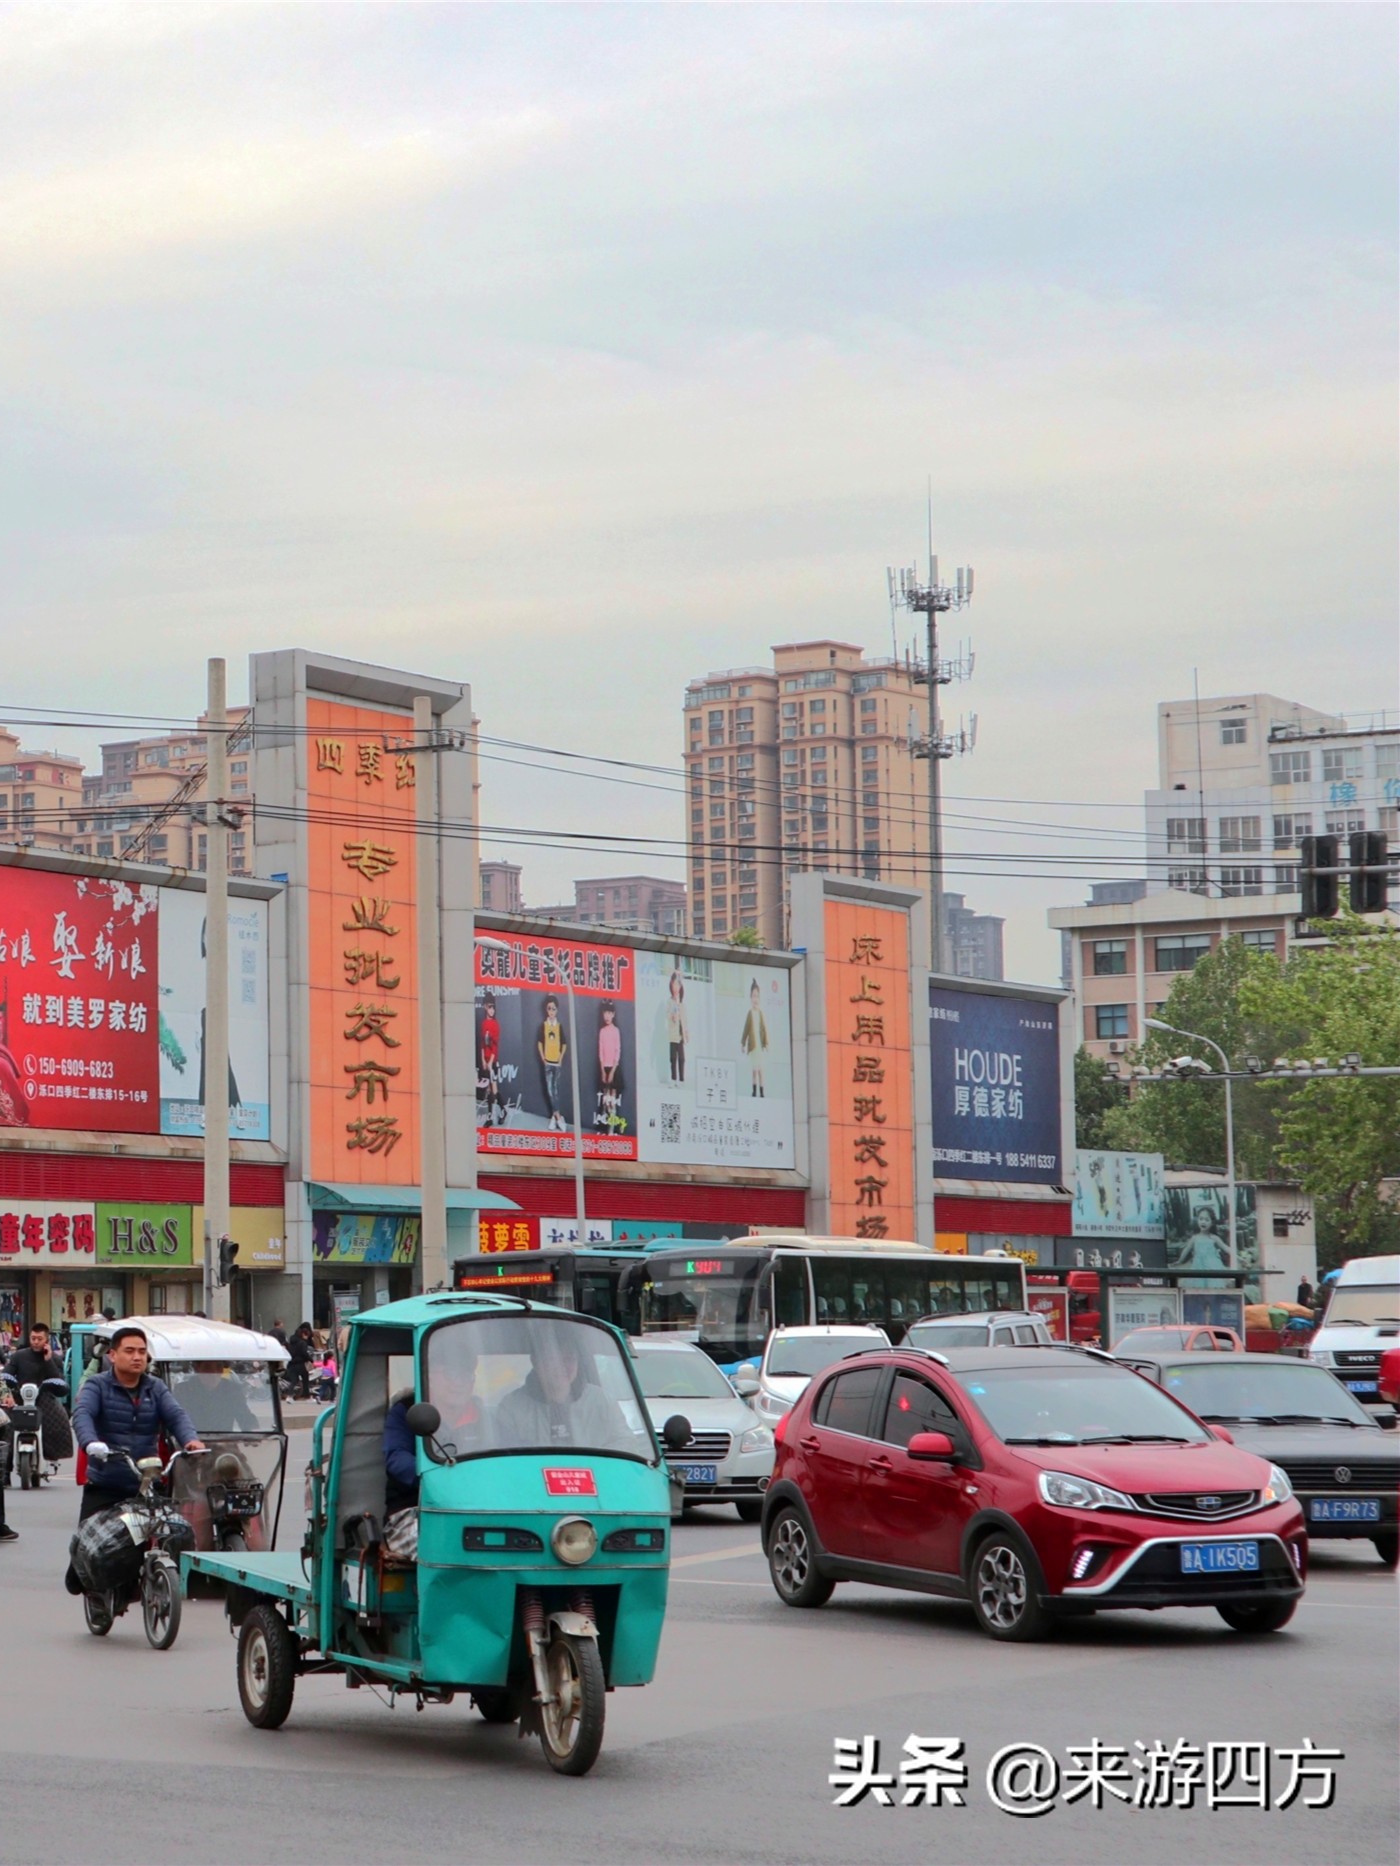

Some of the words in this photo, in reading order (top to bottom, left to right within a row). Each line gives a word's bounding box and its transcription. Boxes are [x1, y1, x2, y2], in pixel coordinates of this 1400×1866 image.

[22, 993, 147, 1033] 就到美罗家纺
[341, 838, 402, 1157] 专业批发市场
[955, 1047, 1022, 1086] HOUDE
[849, 934, 888, 1239] 床上用品批发市场
[954, 1086, 1023, 1119] 厚德家纺
[109, 1217, 179, 1254] H&S
